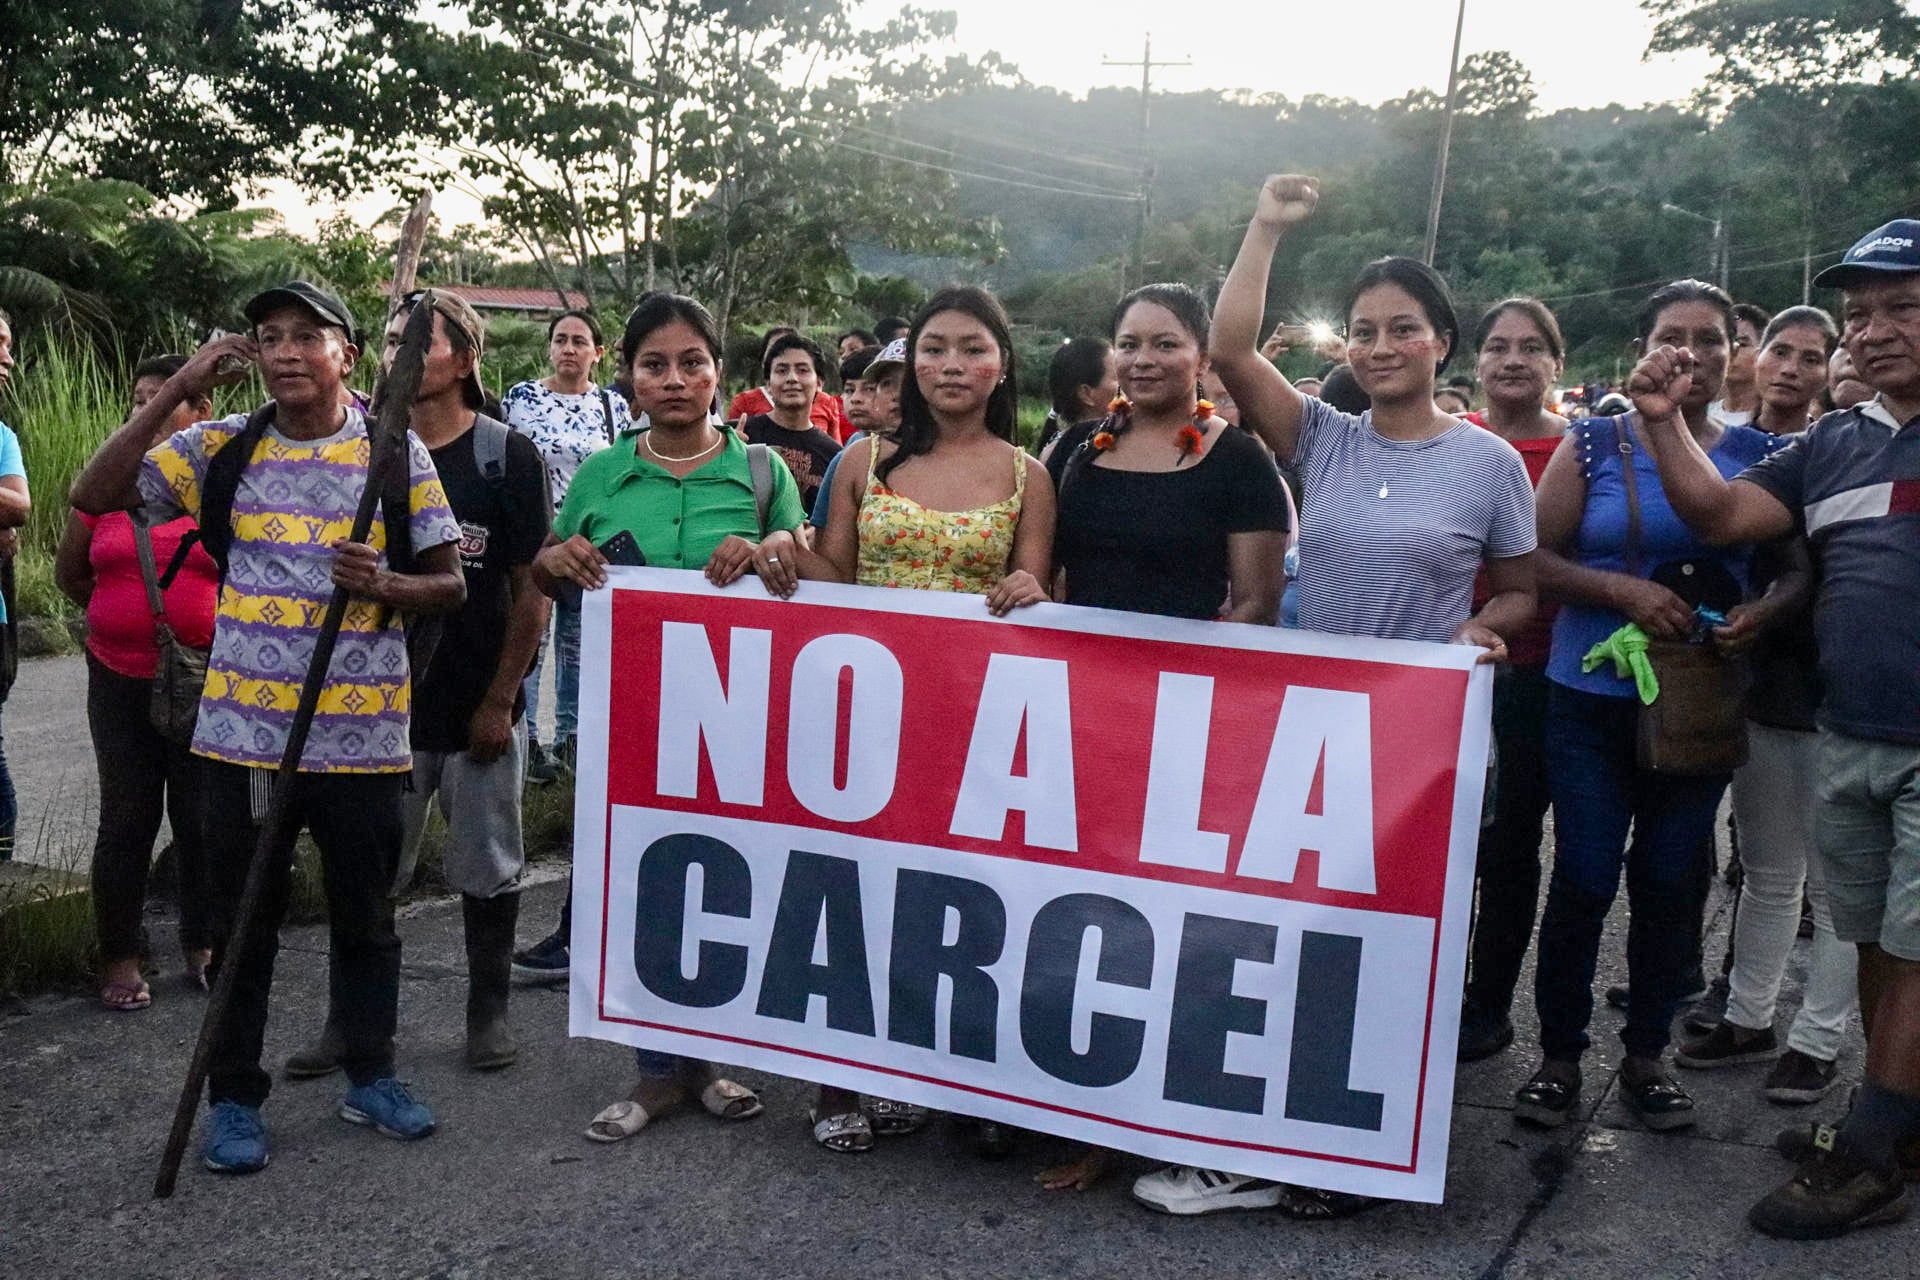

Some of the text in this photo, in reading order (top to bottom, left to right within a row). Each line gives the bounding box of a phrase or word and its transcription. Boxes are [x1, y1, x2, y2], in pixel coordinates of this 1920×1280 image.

[459, 536, 482, 550] 66
[656, 620, 1377, 895] NO A LA
[633, 832, 1385, 1133] CARCEL
